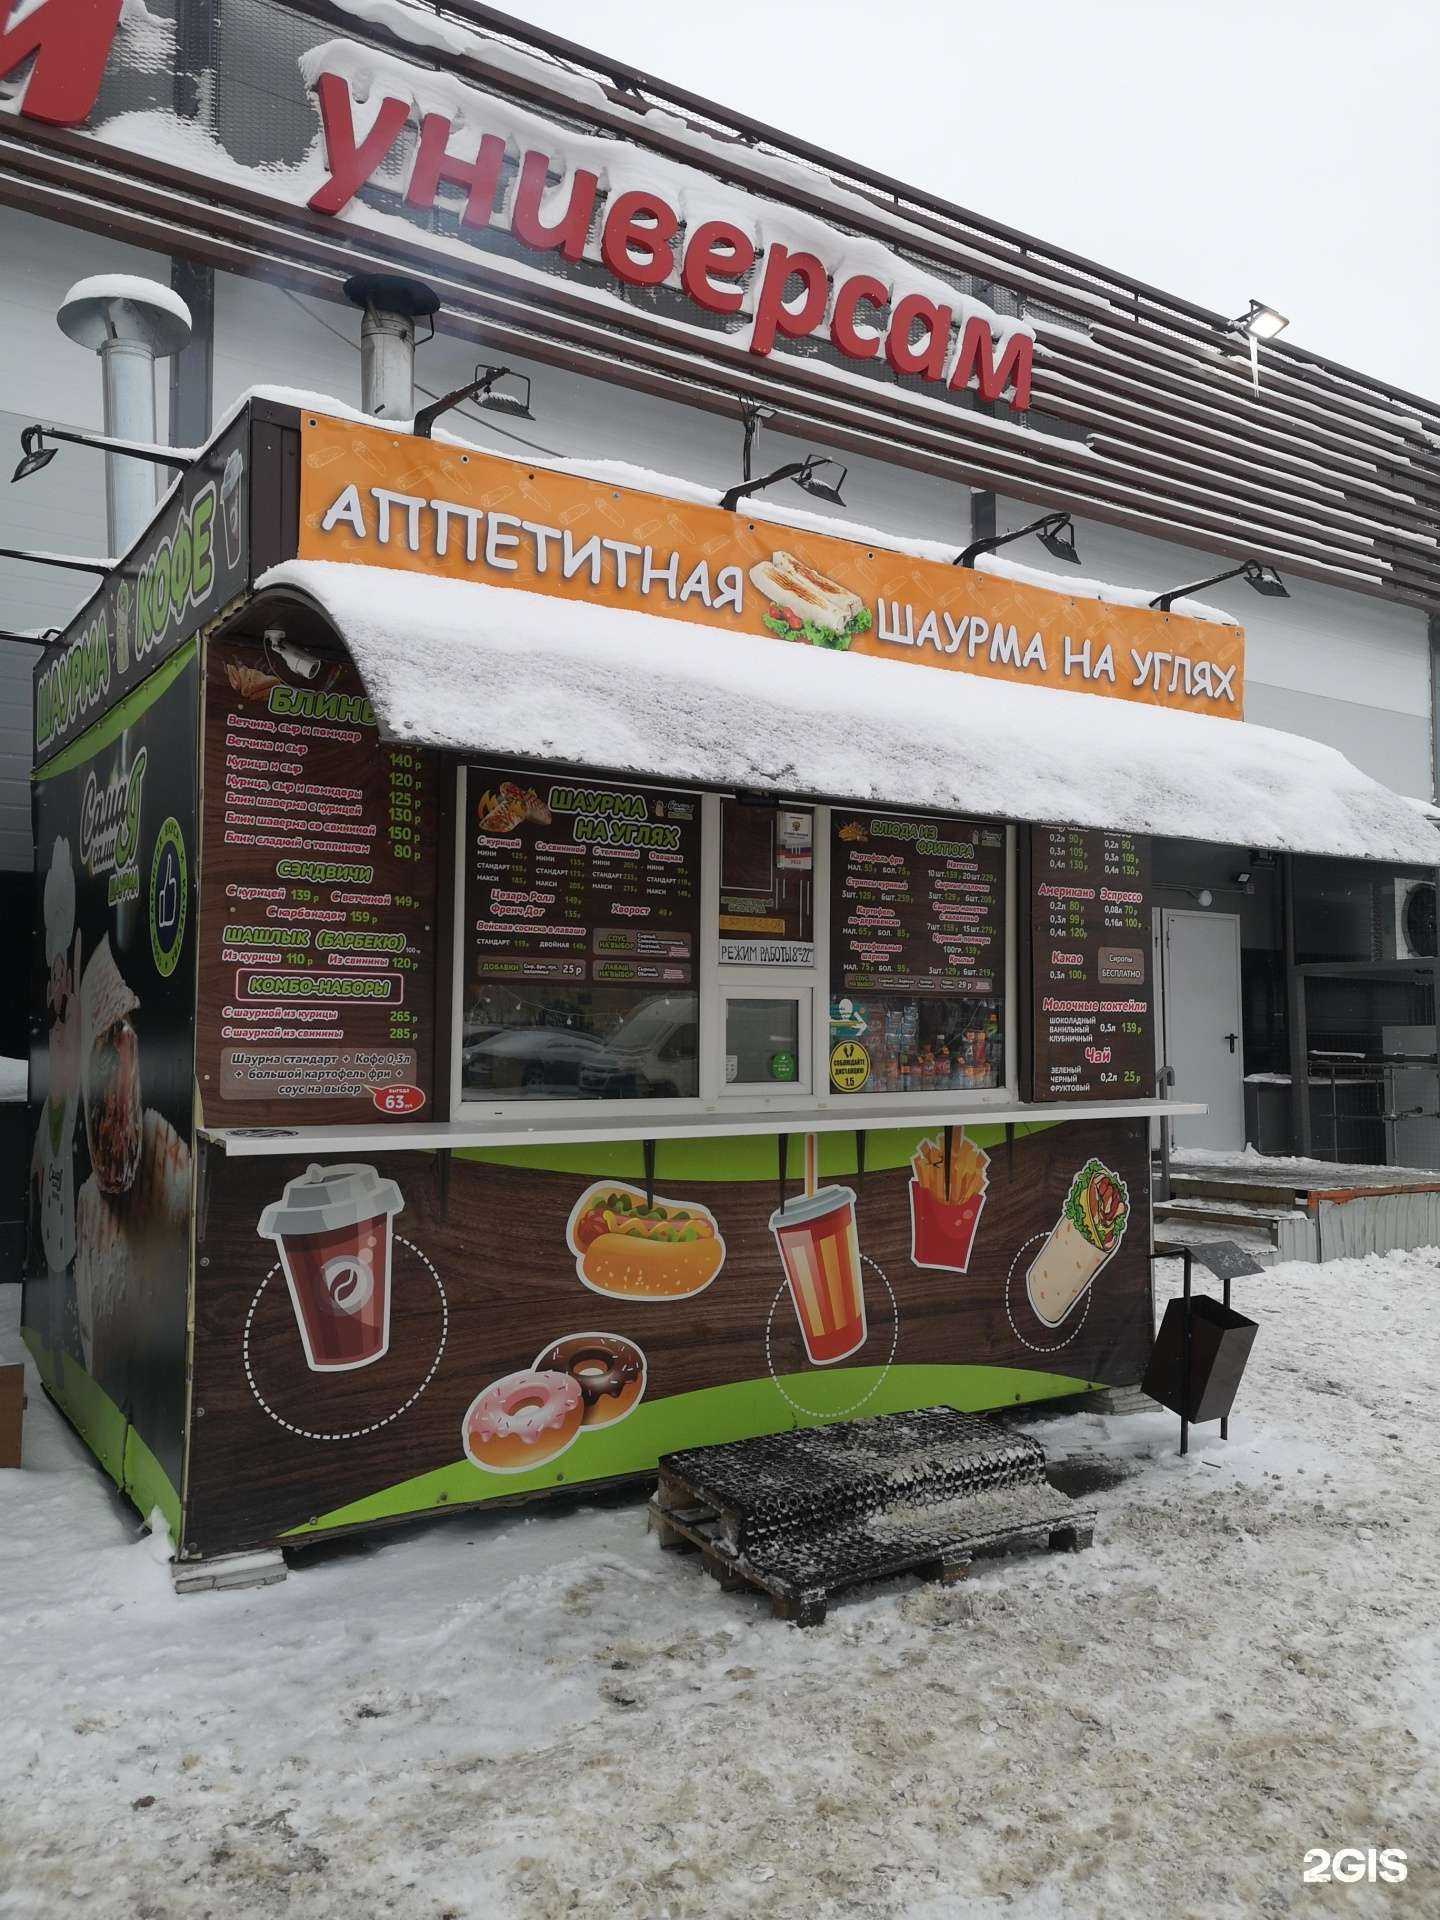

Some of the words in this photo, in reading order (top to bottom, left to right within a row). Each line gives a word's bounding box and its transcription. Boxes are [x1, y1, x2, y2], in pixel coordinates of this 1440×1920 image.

[321, 484, 744, 614] АППЕТИТНАЯ
[135, 480, 217, 661] КОФЕ
[876, 599, 1048, 671] ШАУРМА
[1063, 636, 1116, 683] НА
[1131, 648, 1237, 702] УГЛЯХ
[36, 608, 111, 752] ШАУРМА
[227, 715, 277, 733] Ветчина,
[279, 723, 300, 734] сыр
[312, 728, 361, 743] помидор
[226, 735, 273, 751] Ветчина
[285, 743, 308, 755] сыр
[389, 754, 413, 768] 140
[226, 755, 268, 772] Курица
[280, 763, 303, 775] сыр
[389, 772, 413, 787] 120
[226, 774, 271, 791] Курица,
[272, 782, 294, 793] сыр
[306, 784, 362, 799] помидоры
[389, 792, 413, 806] 125
[225, 792, 255, 806] Блин
[256, 797, 306, 813] шаверма
[318, 803, 362, 816] курицей
[549, 786, 648, 820] ШАУРМА
[225, 812, 254, 826] Блин
[256, 817, 306, 831] шаверма
[308, 821, 323, 831] со
[323, 822, 376, 836] свининой
[387, 827, 412, 841] 150
[573, 816, 608, 842] НА
[609, 819, 681, 850] УГЛЯХ
[870, 819, 918, 840] БЛЮДА
[919, 824, 938, 839] ИЗ
[224, 831, 254, 845] Блин
[256, 834, 301, 849] сладкий
[313, 839, 370, 854] топпингом
[394, 845, 412, 859] 80
[1050, 834, 1065, 843] 0,2л
[1104, 840, 1118, 849] 0,2л
[1050, 847, 1065, 856] 0,3л
[1104, 853, 1119, 862] 0,3л
[1122, 854, 1134, 862] 109
[276, 858, 374, 884] СЭНДВИЧИ
[476, 862, 510, 872] СТАНДАРТ
[535, 866, 568, 877] СТАНДАРТ
[1050, 860, 1065, 869] 0,4л
[1104, 865, 1119, 874] 0,4л
[476, 874, 499, 883] МАКСИ
[592, 871, 623, 880] СТАНДАРТ
[647, 875, 676, 884] СТАНДАРТ
[535, 879, 558, 888] МАКСИ
[226, 884, 237, 897] С
[237, 887, 286, 900] курицей
[331, 891, 341, 902] С
[341, 893, 392, 906] ветчиной
[394, 896, 413, 908] 149
[491, 888, 528, 903] Цезарь
[529, 890, 555, 903] Ролл
[1038, 883, 1095, 900] Американо
[1100, 887, 1142, 904] Эспрессо
[490, 903, 524, 917] Френч
[524, 905, 545, 918] Дог
[611, 902, 650, 917] Хворост
[1050, 902, 1066, 910] 0,2л
[266, 905, 277, 917] С
[278, 907, 346, 922] карбонадом
[351, 911, 370, 923] 159
[1050, 915, 1066, 924] 0,3л
[476, 920, 513, 932] Венская
[1124, 919, 1137, 928] 100
[223, 925, 312, 948] ШАШЛЫК
[315, 929, 407, 954] (БАРБЕКЮ)
[1050, 928, 1066, 937] 0,4л
[1070, 928, 1084, 937] 120
[476, 938, 510, 947] СТАНДАРТ
[539, 940, 570, 949] ДВОЙНАЯ
[222, 950, 239, 962] Из
[240, 951, 282, 965] курицы
[287, 954, 305, 965] 110
[328, 953, 342, 965] Из
[344, 955, 389, 968] свинины
[392, 957, 411, 969] 120
[721, 945, 757, 960] РЕЖИМ
[759, 946, 791, 963] РАБОТЫ
[1051, 951, 1084, 965] Какао
[1109, 954, 1133, 964] Сиропы
[563, 963, 575, 974] 25
[1069, 971, 1082, 979] 100
[1102, 968, 1141, 979] БЕСПЛАТНО
[248, 976, 391, 998] КОМБО-НАБОРЫ
[1043, 997, 1099, 1012] Молочные
[1100, 999, 1147, 1013] коктейли
[234, 1007, 283, 1020] шаурмой
[283, 1009, 296, 1019] из
[298, 1009, 339, 1021] курицы
[390, 1011, 410, 1022] 265
[1049, 1017, 1096, 1025] ШОКОЛАДНЫЙ
[234, 1028, 281, 1040] шаурмой
[282, 1029, 296, 1038] из
[297, 1029, 344, 1040] свинины
[389, 1029, 410, 1039] 285
[1049, 1025, 1089, 1033] ВАНИЛЬНЫЙ
[1100, 1023, 1116, 1033] 0,5л
[1122, 1022, 1137, 1033] 139
[1049, 1034, 1093, 1043] КЛУБНИЧНЫЙ
[231, 1053, 281, 1066] Шаурма
[283, 1055, 338, 1065] стандарт
[355, 1054, 386, 1066] Кофе
[387, 1054, 412, 1065] 0,3л
[1084, 1047, 1111, 1064] Чай
[248, 1068, 302, 1080] большой
[304, 1070, 366, 1080] картофель
[368, 1069, 392, 1080] фри
[1050, 1074, 1077, 1083] ЧЕРНЫЙ
[1100, 1072, 1118, 1082] 0,2л
[1124, 1071, 1135, 1082] 25
[278, 1085, 305, 1095] соус
[308, 1085, 322, 1094] на
[324, 1083, 361, 1095] выбор
[1050, 1084, 1090, 1092] ФРУКТОВЫЙ
[385, 1095, 404, 1109] 63
